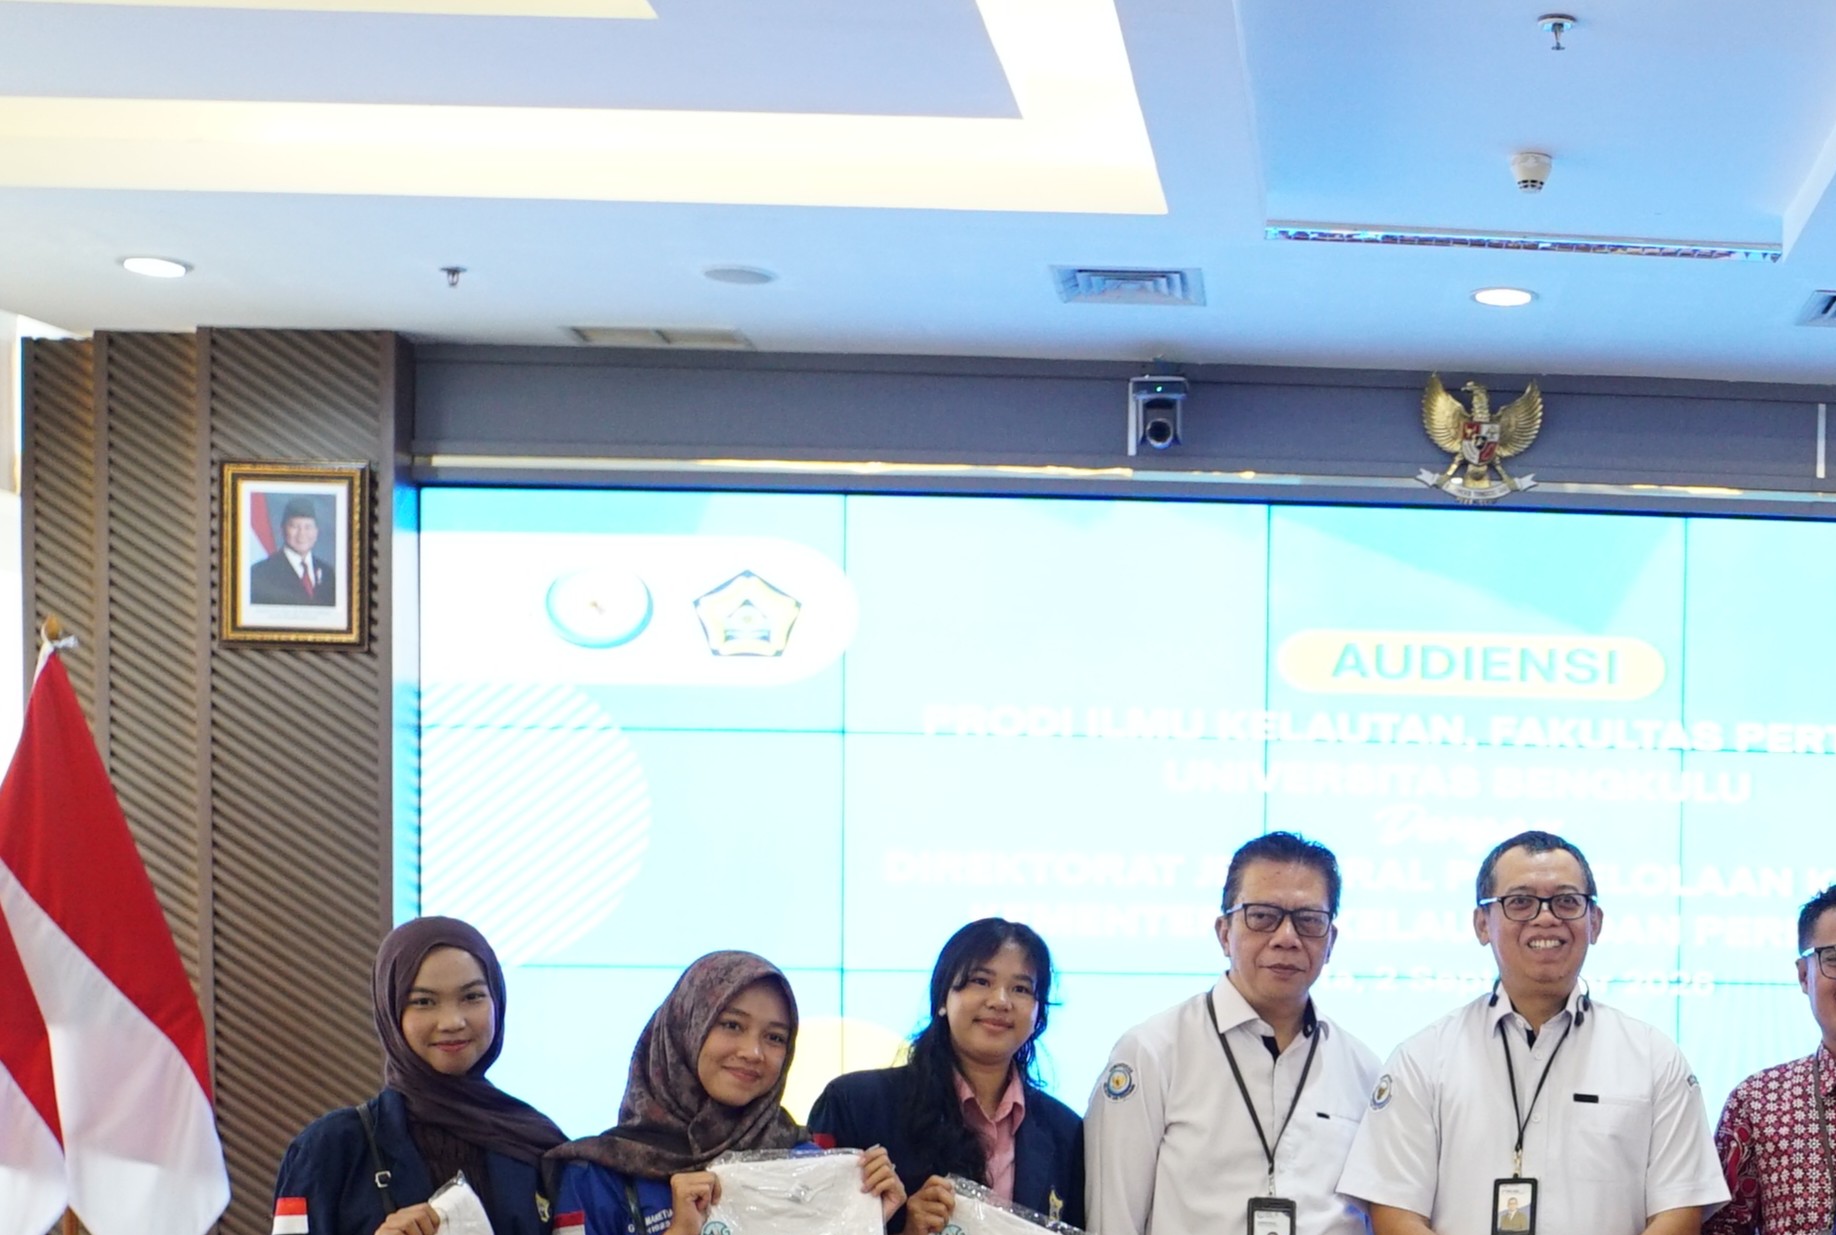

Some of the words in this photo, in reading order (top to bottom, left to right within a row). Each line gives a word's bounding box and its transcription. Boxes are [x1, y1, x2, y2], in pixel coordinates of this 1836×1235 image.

[1330, 641, 1619, 687] AUDIENSI
[921, 702, 1074, 737] PRODI
[1085, 704, 1206, 739] ILMU
[1216, 707, 1478, 752] KELAUTAN,
[1489, 714, 1724, 752] FAKULTAS
[1161, 759, 1480, 800] UNIVERSITAS
[1492, 767, 1753, 805] BENGKULU
[881, 849, 1185, 887] DIREKTORAT
